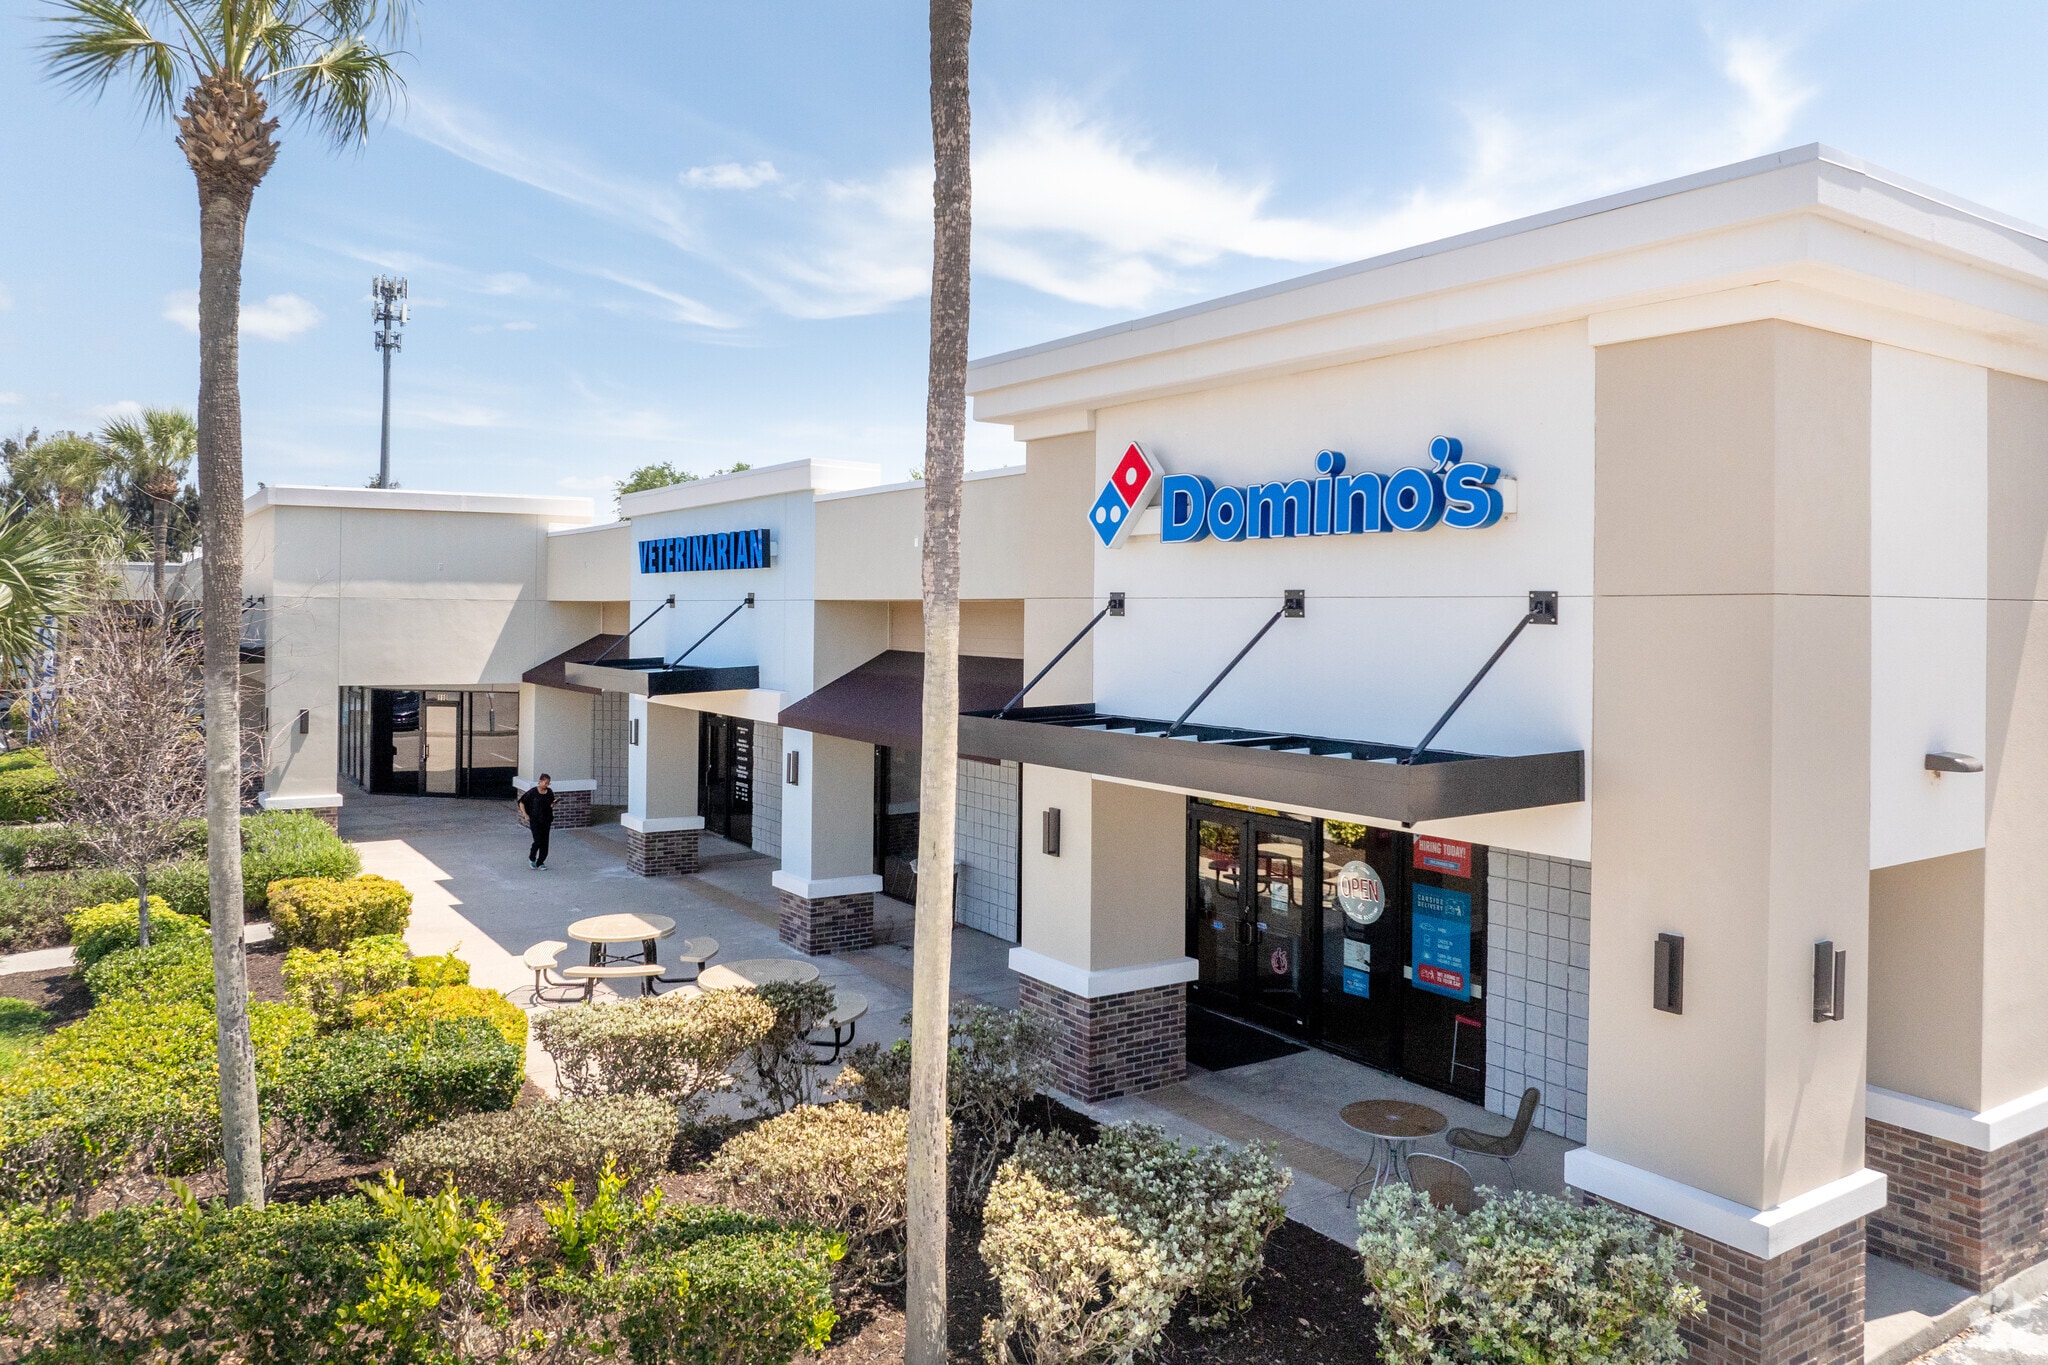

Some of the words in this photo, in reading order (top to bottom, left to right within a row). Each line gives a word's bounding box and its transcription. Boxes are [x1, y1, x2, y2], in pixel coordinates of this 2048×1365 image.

[1160, 435, 1501, 543] Domino's
[639, 529, 768, 574] VETERINARIAN
[1418, 839, 1442, 854] HIRING
[1443, 843, 1466, 859] TODAY!
[1341, 875, 1379, 902] OPEN
[1417, 900, 1443, 911] DELIVERY
